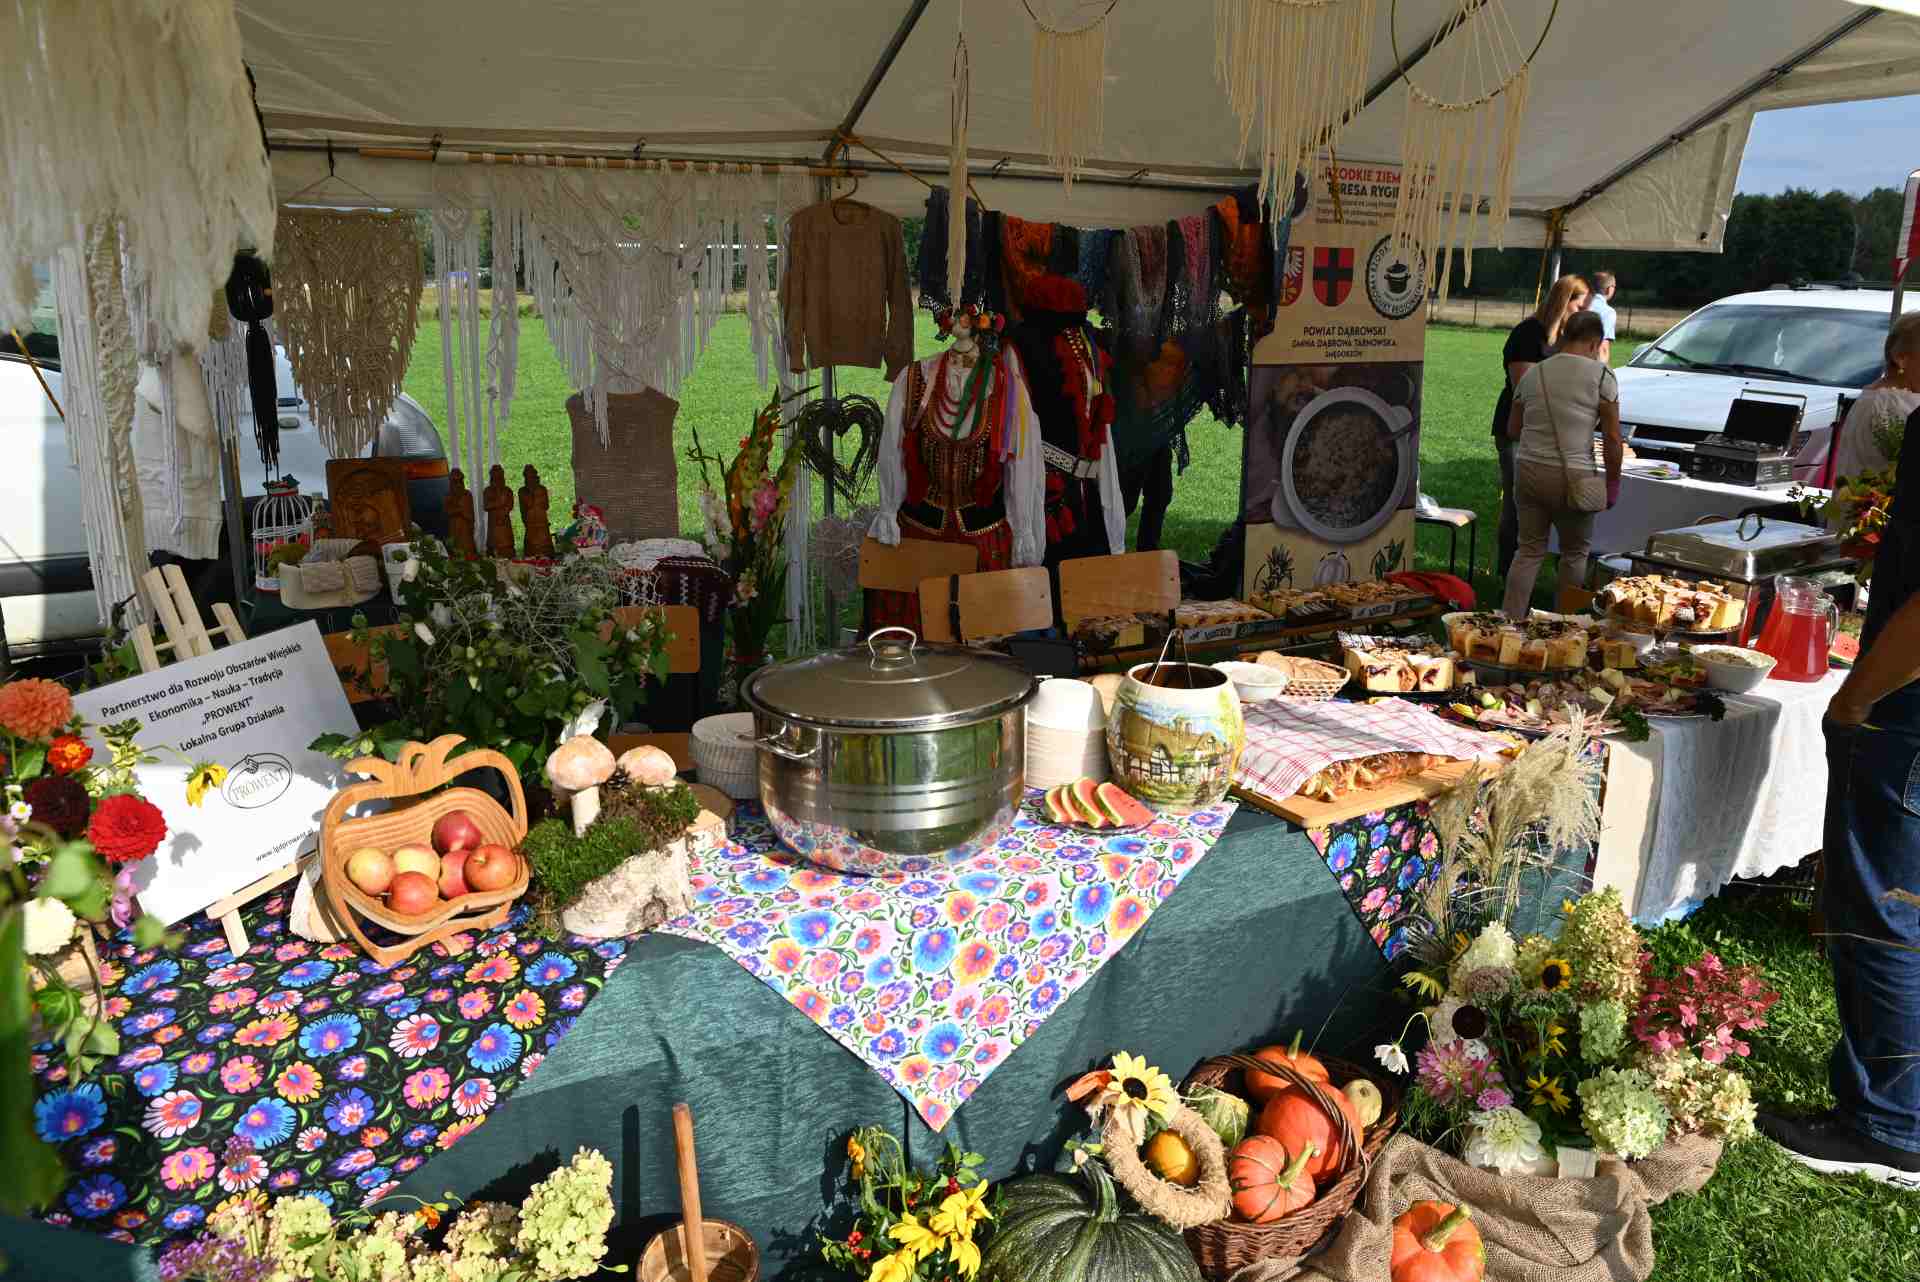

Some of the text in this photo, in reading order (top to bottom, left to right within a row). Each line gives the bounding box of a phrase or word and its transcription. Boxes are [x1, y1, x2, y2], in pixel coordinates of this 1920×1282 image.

[1327, 182, 1368, 196] TRESA
[1303, 326, 1335, 337] POWIAT
[101, 643, 303, 718] Partnerstwo dla Rozwoju Obszarów Wiejskich
[148, 697, 204, 723] Ekonomika
[211, 682, 242, 699] Nauka
[247, 668, 284, 689] Tradycja
[180, 704, 285, 752] Lokalna Grupa Działania
[231, 768, 285, 800] PROWENT
